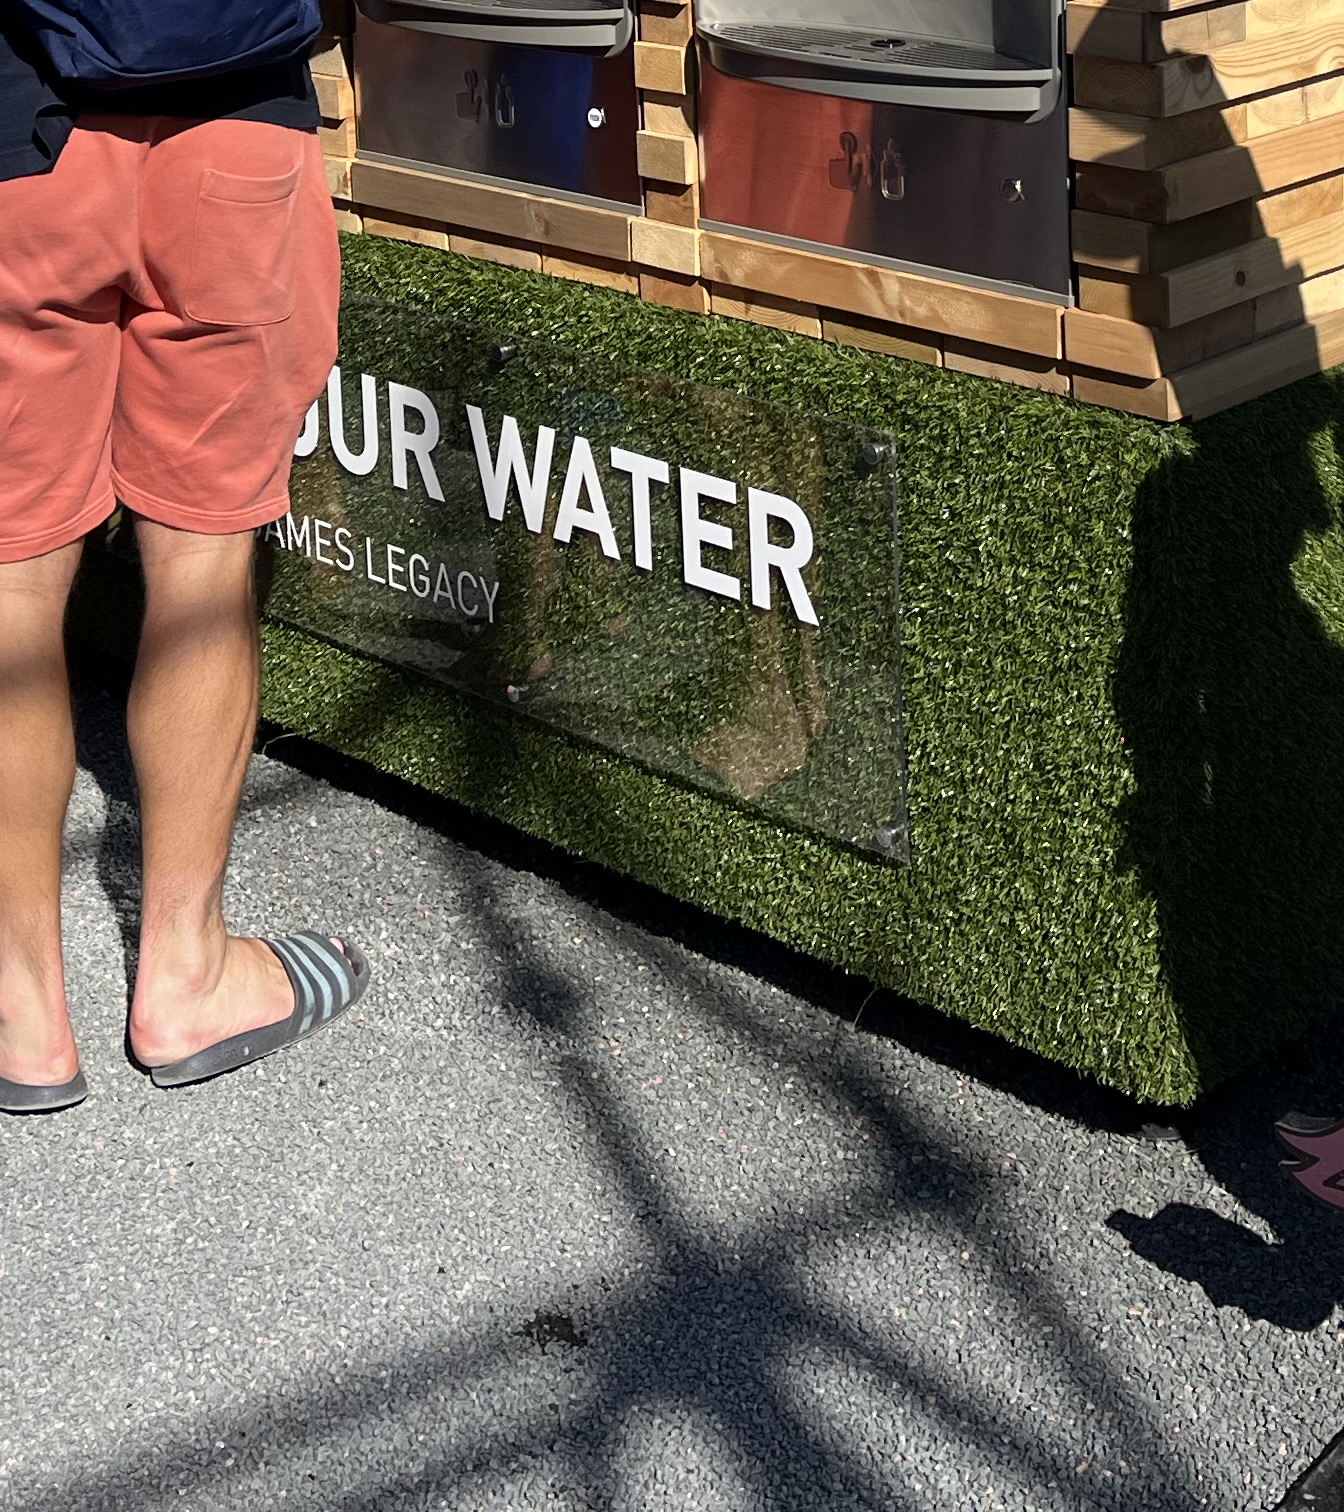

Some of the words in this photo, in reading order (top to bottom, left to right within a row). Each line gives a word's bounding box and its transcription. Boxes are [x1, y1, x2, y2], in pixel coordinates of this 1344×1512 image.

[256, 512, 355, 572] AMES
[366, 536, 499, 624] LEGACY
[465, 404, 820, 627] WATER
